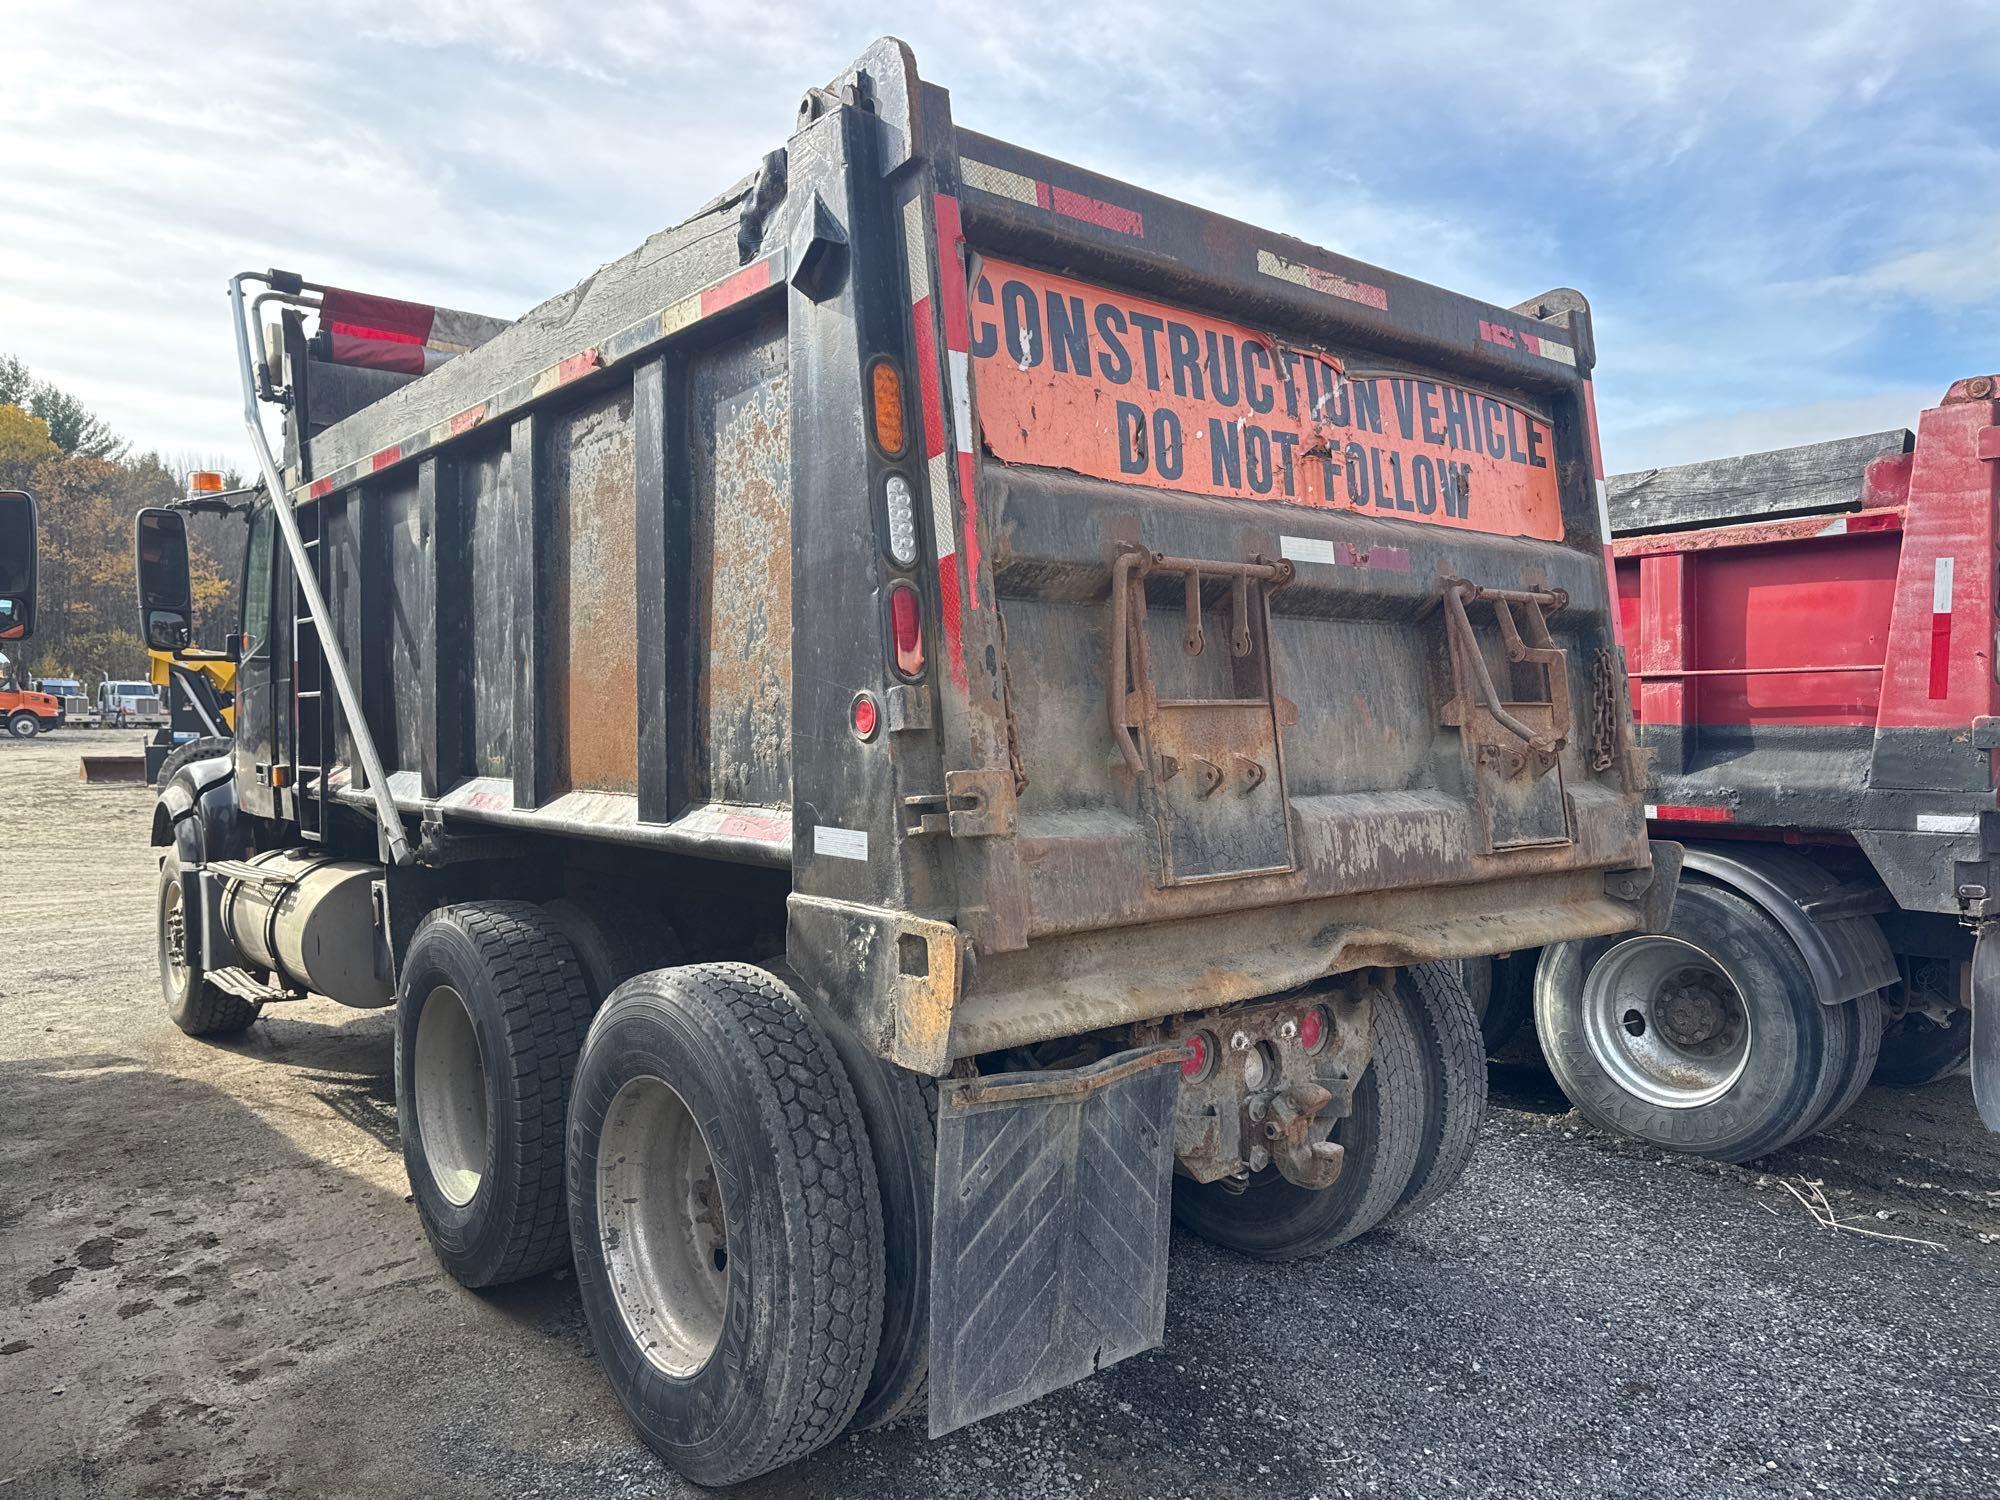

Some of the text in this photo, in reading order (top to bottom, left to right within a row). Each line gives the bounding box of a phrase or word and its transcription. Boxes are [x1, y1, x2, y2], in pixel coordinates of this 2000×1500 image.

[971, 275, 1547, 468] CONSTRUCTION VEHICLE
[1116, 400, 1471, 520] DO NOT FOLLOW
[1558, 1031, 1737, 1141] GOODYEAR
[704, 1115, 750, 1372] DAYTON
